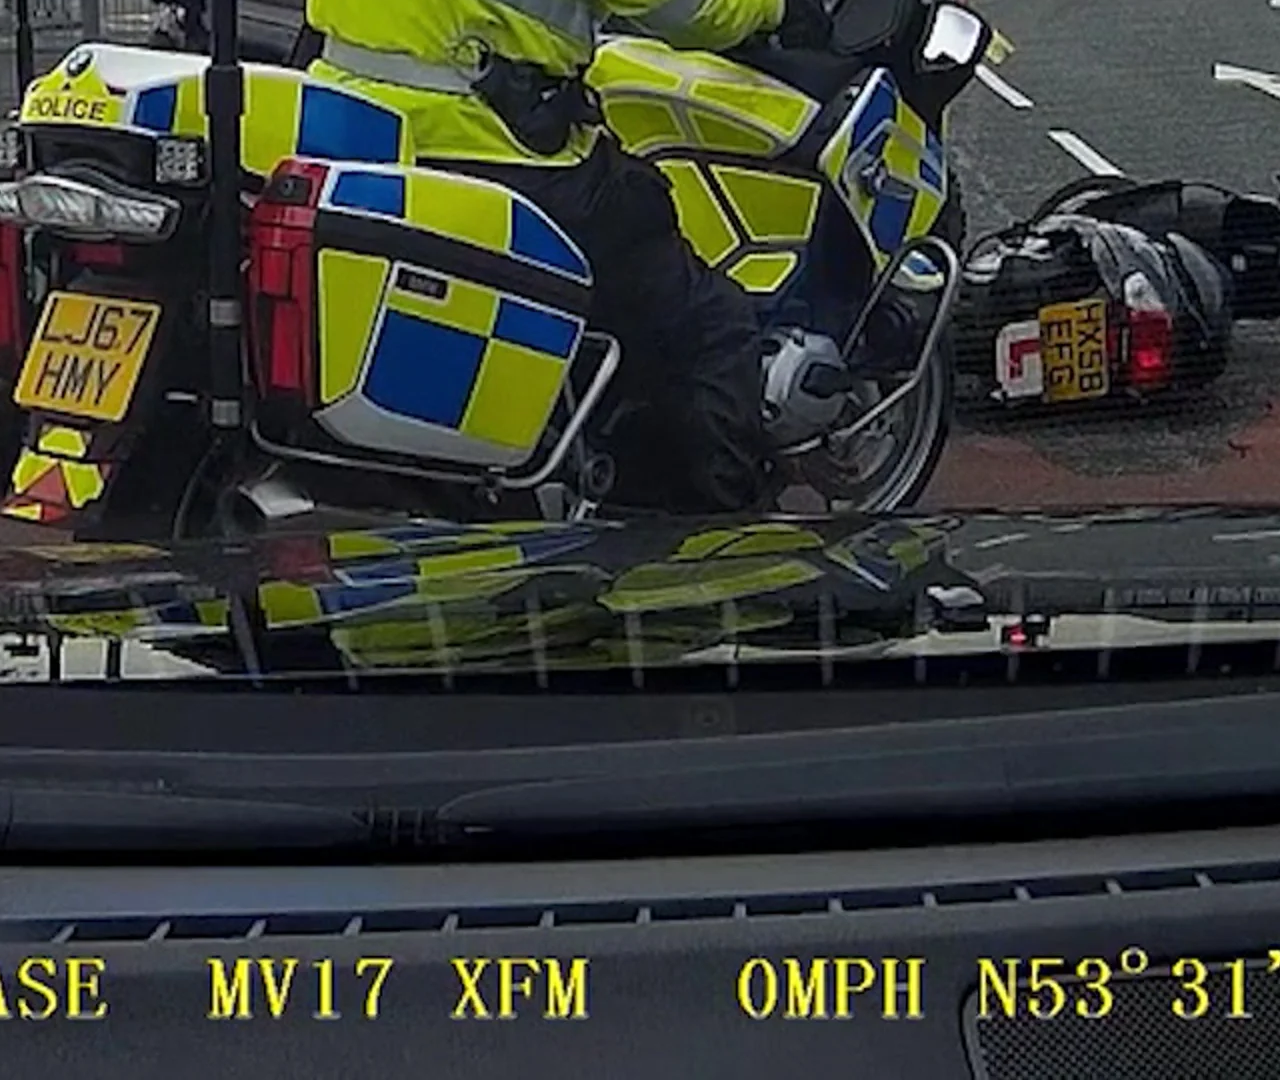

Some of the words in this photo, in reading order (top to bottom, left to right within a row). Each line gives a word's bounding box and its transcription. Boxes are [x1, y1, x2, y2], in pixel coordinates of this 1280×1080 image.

[29, 95, 108, 121] POLICE
[42, 297, 153, 355] LJ67
[34, 351, 122, 406] HMY
